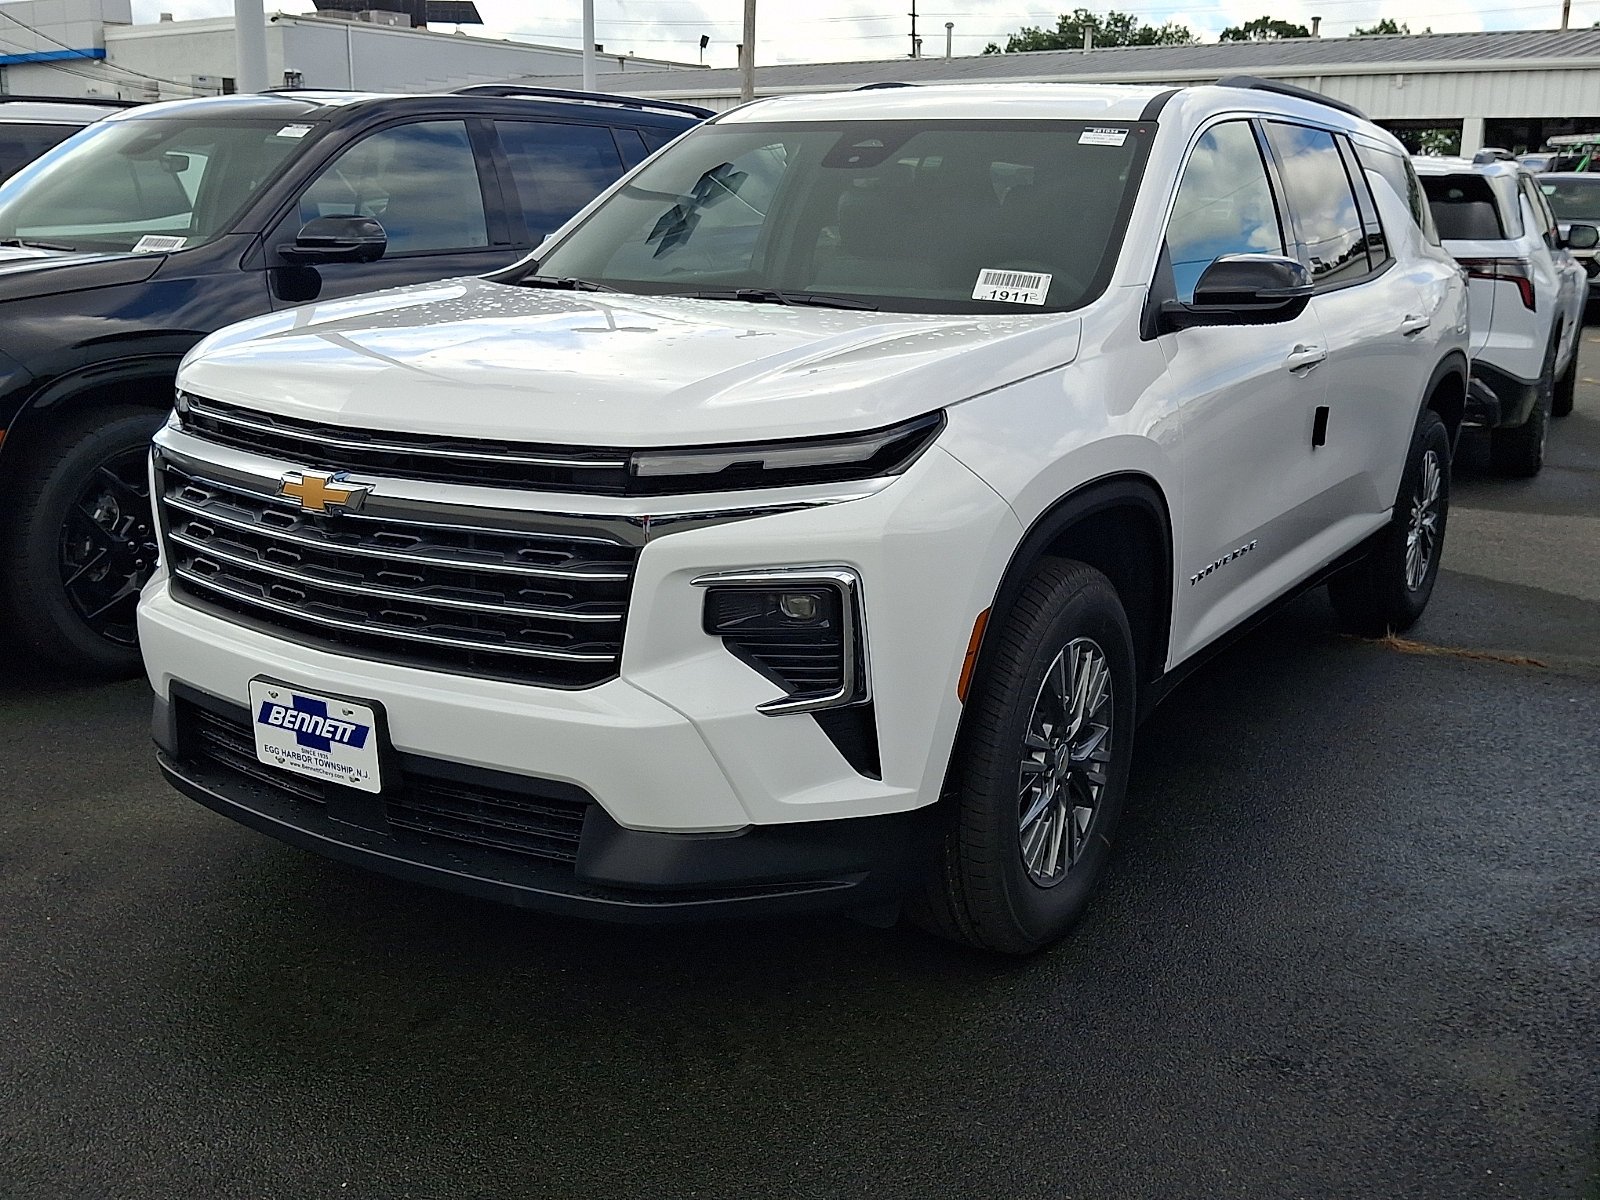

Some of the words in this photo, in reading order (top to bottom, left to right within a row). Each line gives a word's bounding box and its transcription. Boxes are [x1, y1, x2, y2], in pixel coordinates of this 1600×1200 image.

[1190, 539, 1257, 586] TRAVERSE
[268, 705, 356, 742] BENNETT
[264, 744, 279, 755] EGG
[281, 748, 312, 763] HARBOR
[301, 748, 316, 756] SINCE
